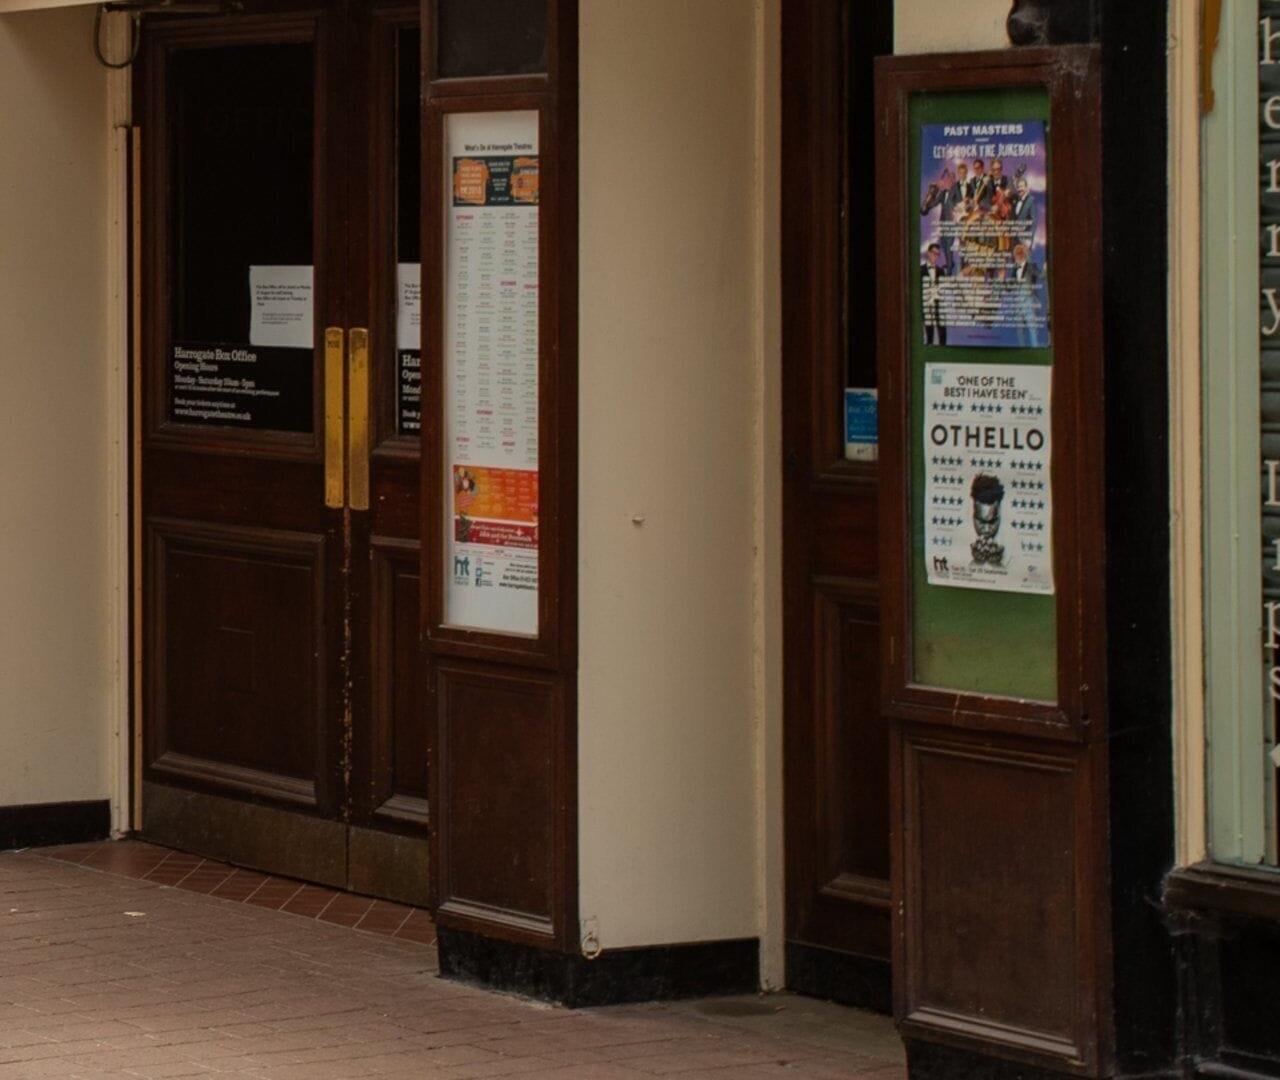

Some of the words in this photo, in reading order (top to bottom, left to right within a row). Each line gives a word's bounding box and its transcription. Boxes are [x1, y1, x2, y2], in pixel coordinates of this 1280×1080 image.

[943, 125, 969, 137] PAST
[972, 123, 1024, 136] MASTERS
[979, 143, 996, 158] THE
[998, 142, 1036, 158] JUKEBOX
[174, 346, 215, 362] Harrogate
[215, 348, 231, 361] Box
[231, 349, 257, 362] Office
[174, 361, 200, 373] Opening
[981, 376, 994, 387] OF
[996, 376, 1015, 388] THE
[944, 387, 966, 398] BEST
[972, 388, 999, 400] HAVE
[931, 424, 1044, 451] OTHELLO
